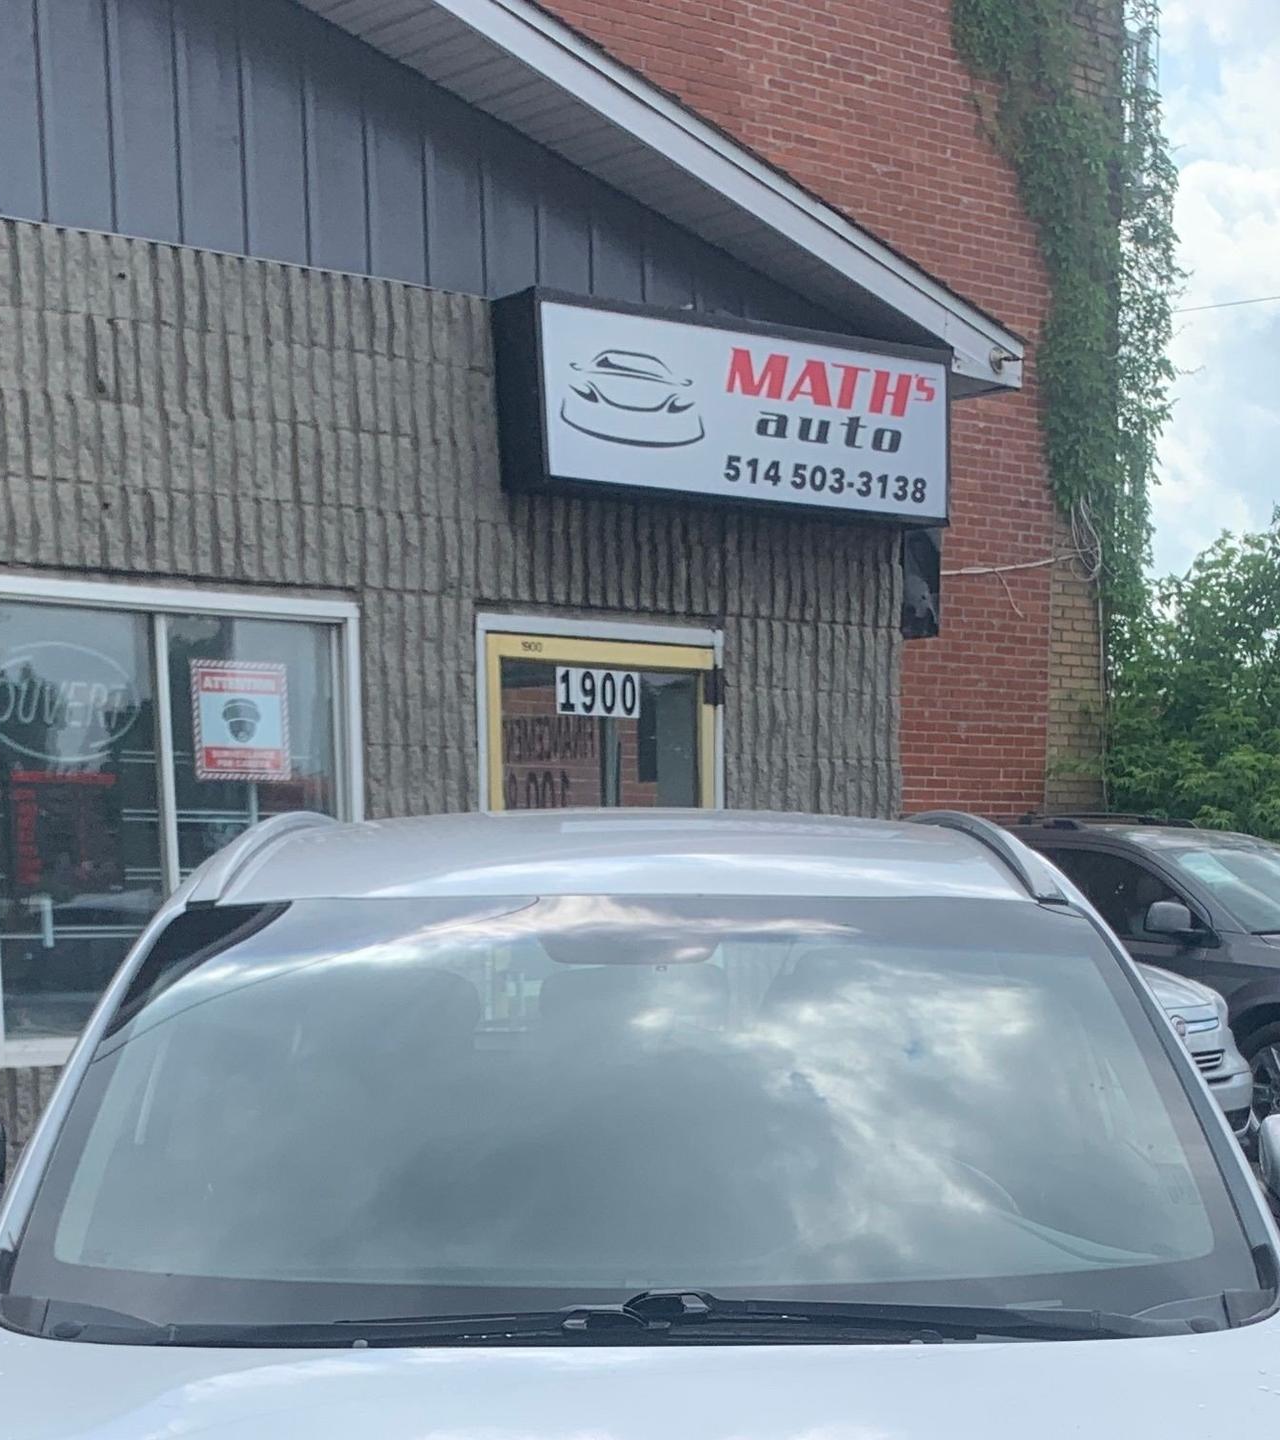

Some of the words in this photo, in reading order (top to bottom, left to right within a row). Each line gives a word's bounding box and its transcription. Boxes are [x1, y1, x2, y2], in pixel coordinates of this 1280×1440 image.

[755, 410, 903, 454] auto
[723, 454, 782, 487] 514
[790, 463, 928, 504] 503-3138
[521, 640, 543, 653] 1900
[559, 669, 637, 716] 1900
